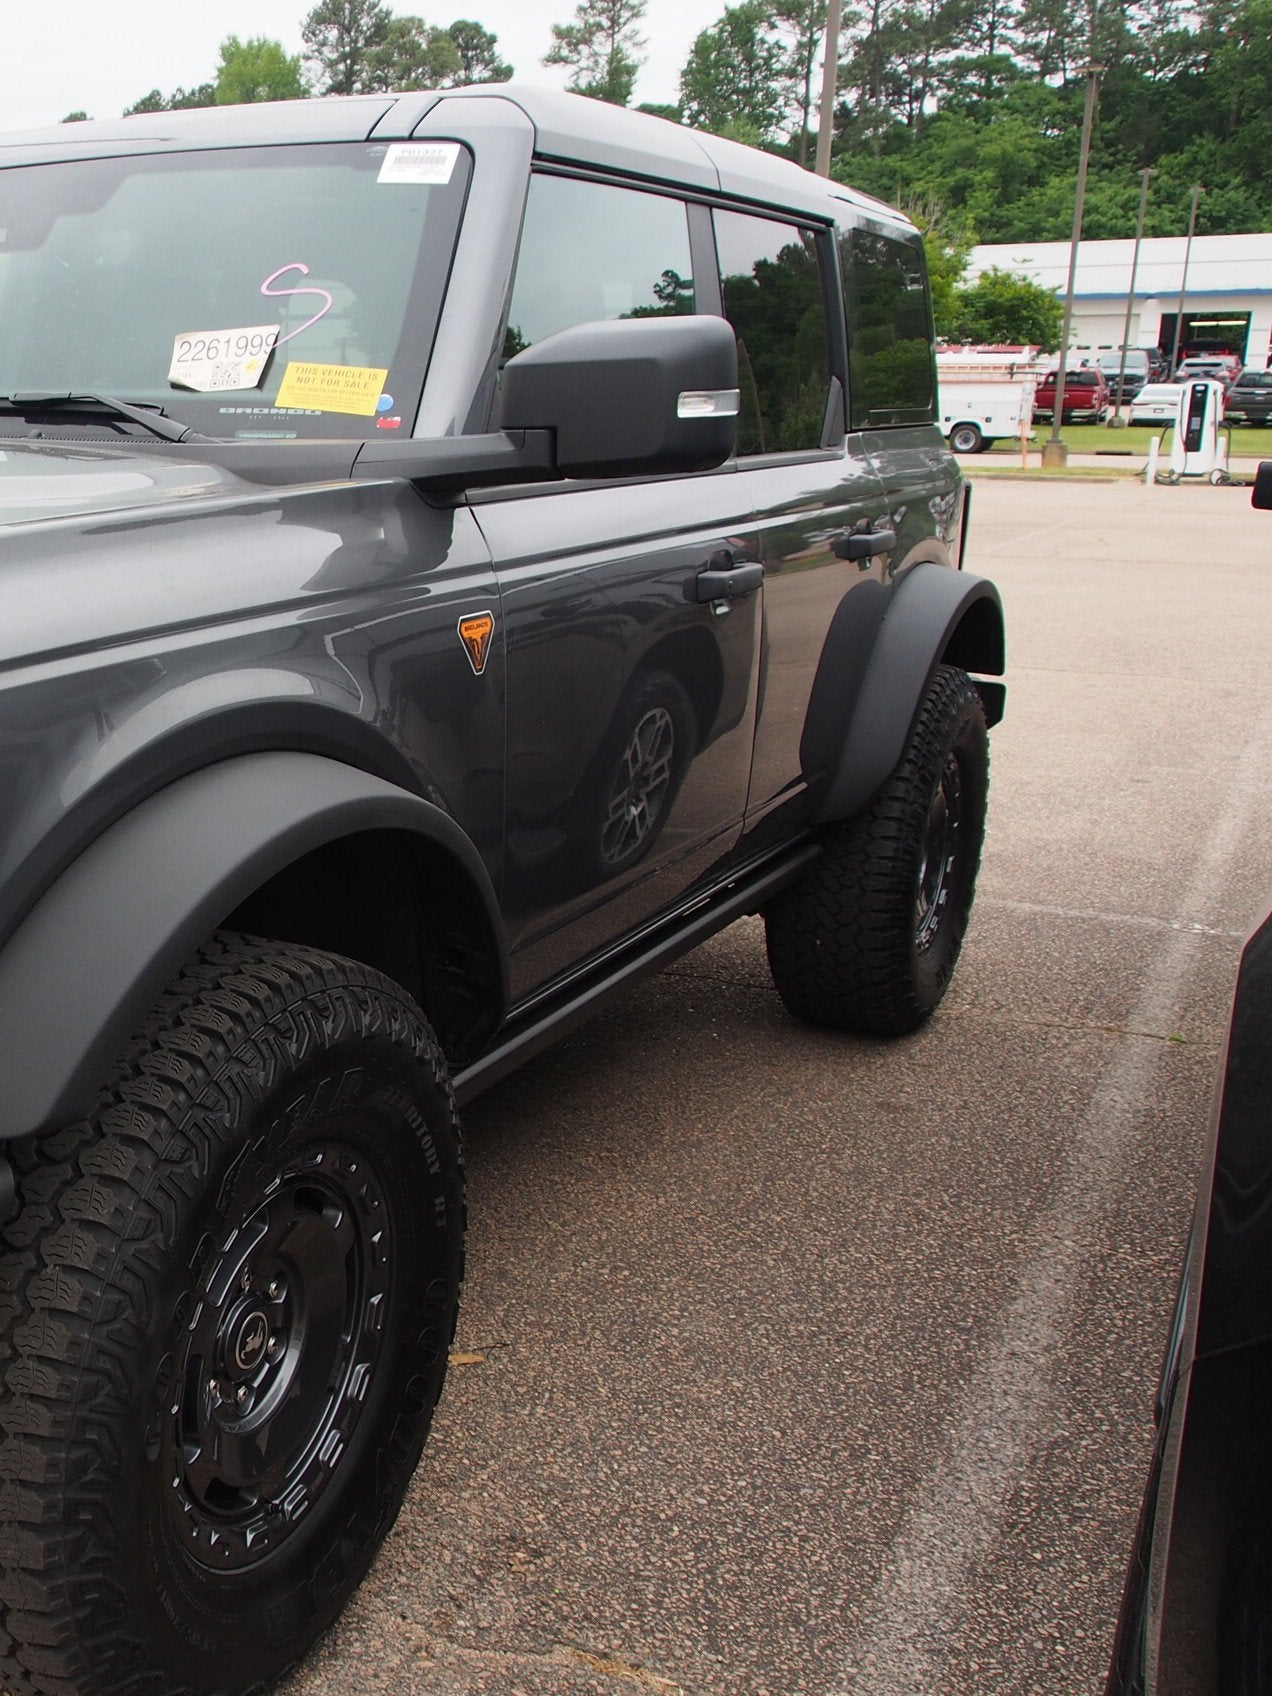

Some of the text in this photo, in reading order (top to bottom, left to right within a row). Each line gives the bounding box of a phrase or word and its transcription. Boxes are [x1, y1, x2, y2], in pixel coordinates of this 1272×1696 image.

[295, 367, 318, 375] THIS
[322, 369, 364, 380] VEHICLE
[343, 381, 370, 390] SALE
